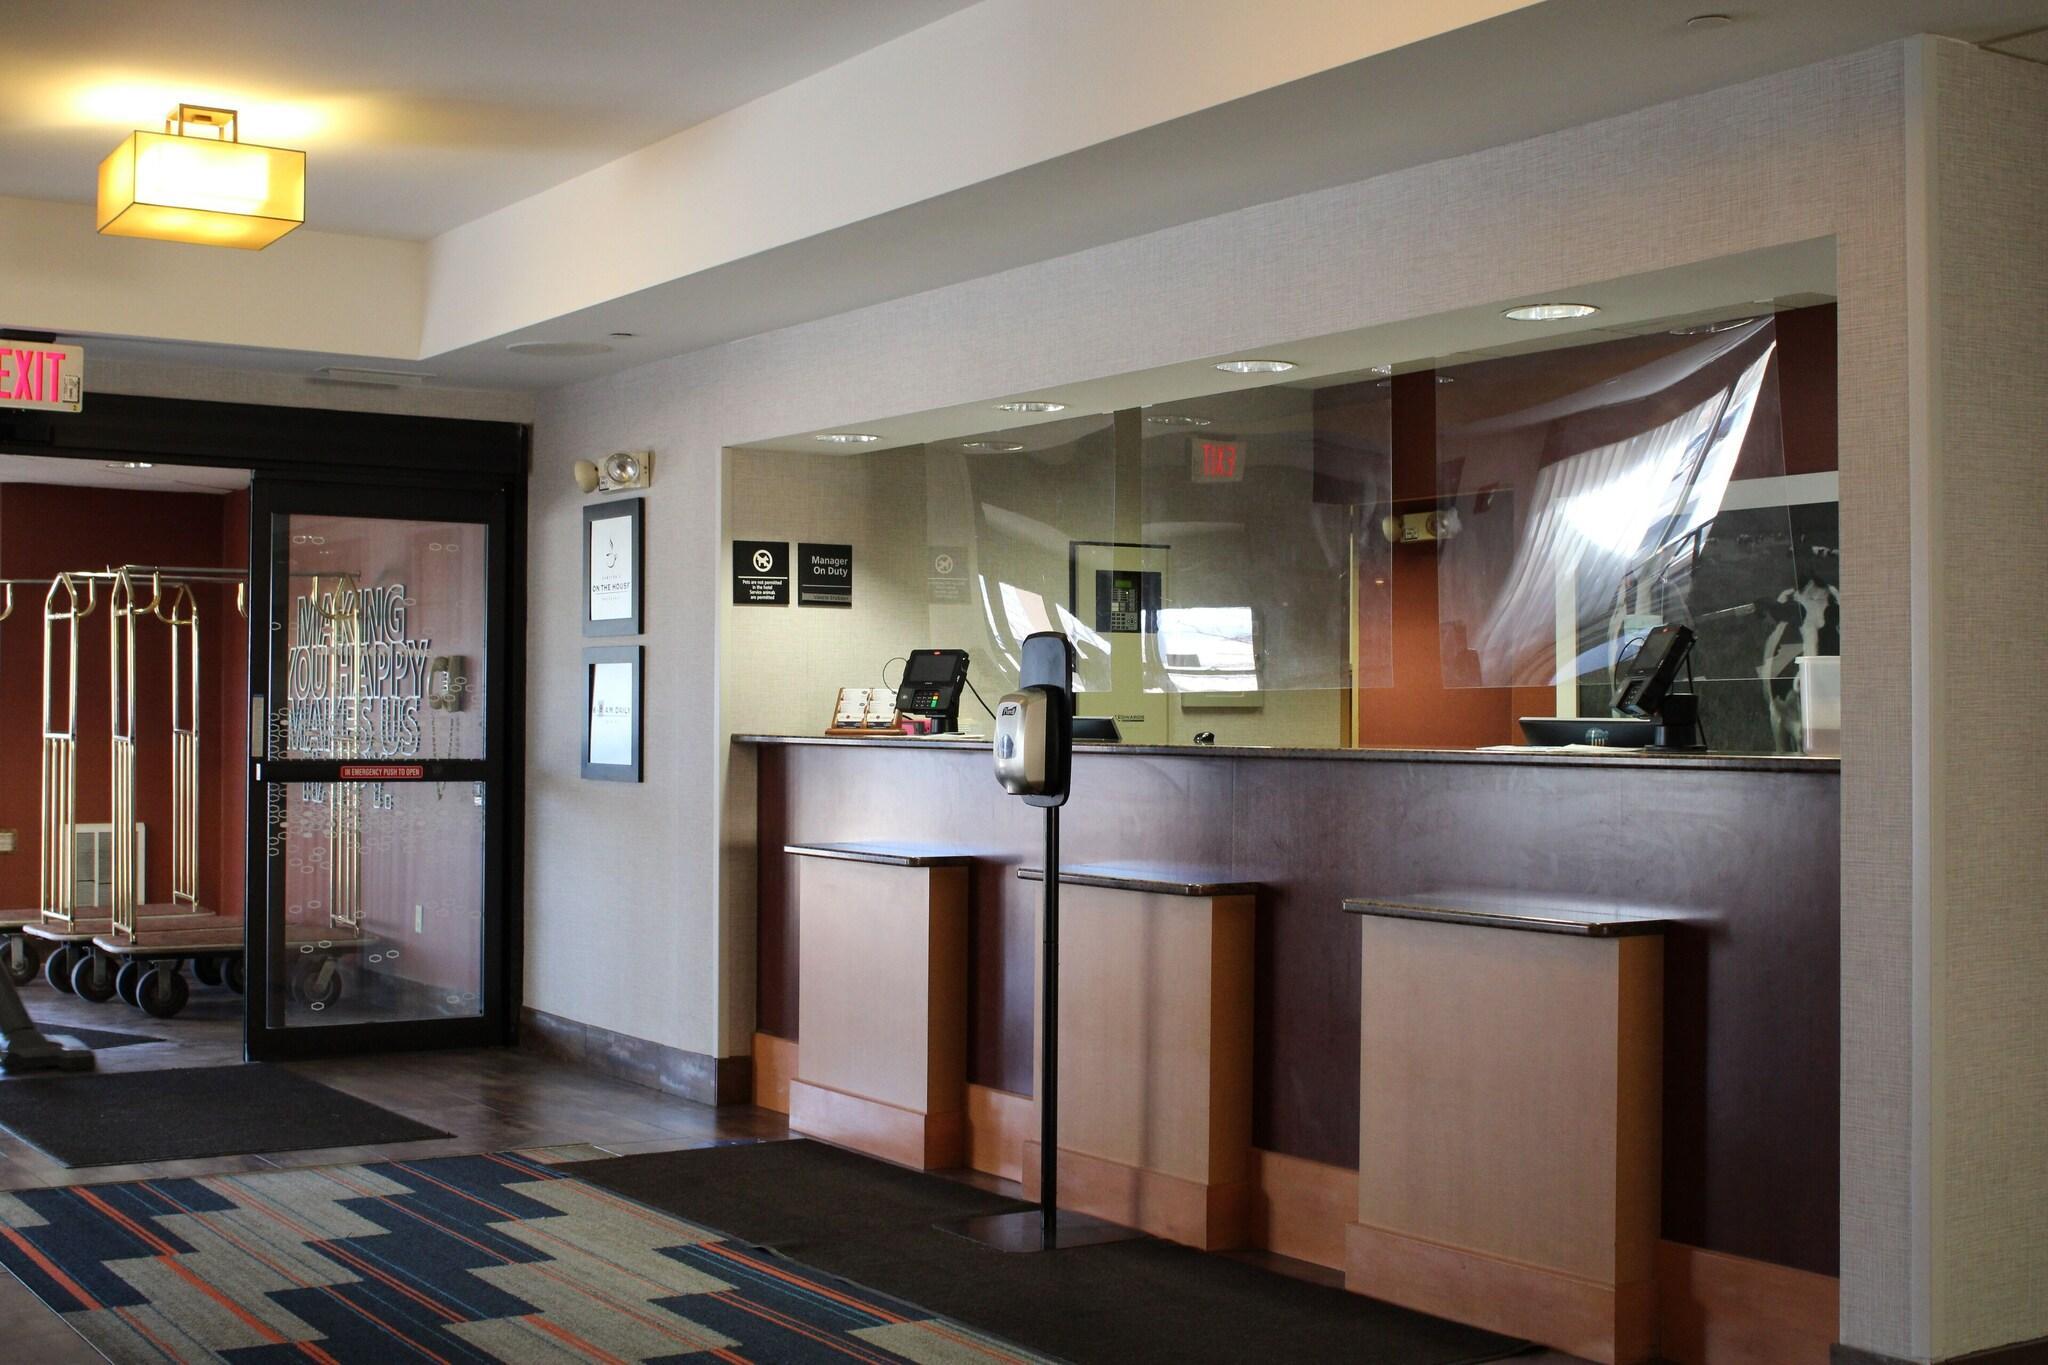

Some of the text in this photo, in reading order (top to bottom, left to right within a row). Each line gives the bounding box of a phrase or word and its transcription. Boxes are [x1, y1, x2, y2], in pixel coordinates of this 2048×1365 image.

[0, 347, 66, 403] EXIT
[811, 555, 848, 567] Manager
[813, 566, 848, 578] On Duty
[592, 584, 600, 593] ON
[600, 583, 611, 592] THE
[296, 583, 406, 649] MAKING
[337, 638, 430, 701] HAPPY
[380, 696, 422, 757] US
[344, 768, 420, 776] IN EMERGENCY PUSH TO OPEN
